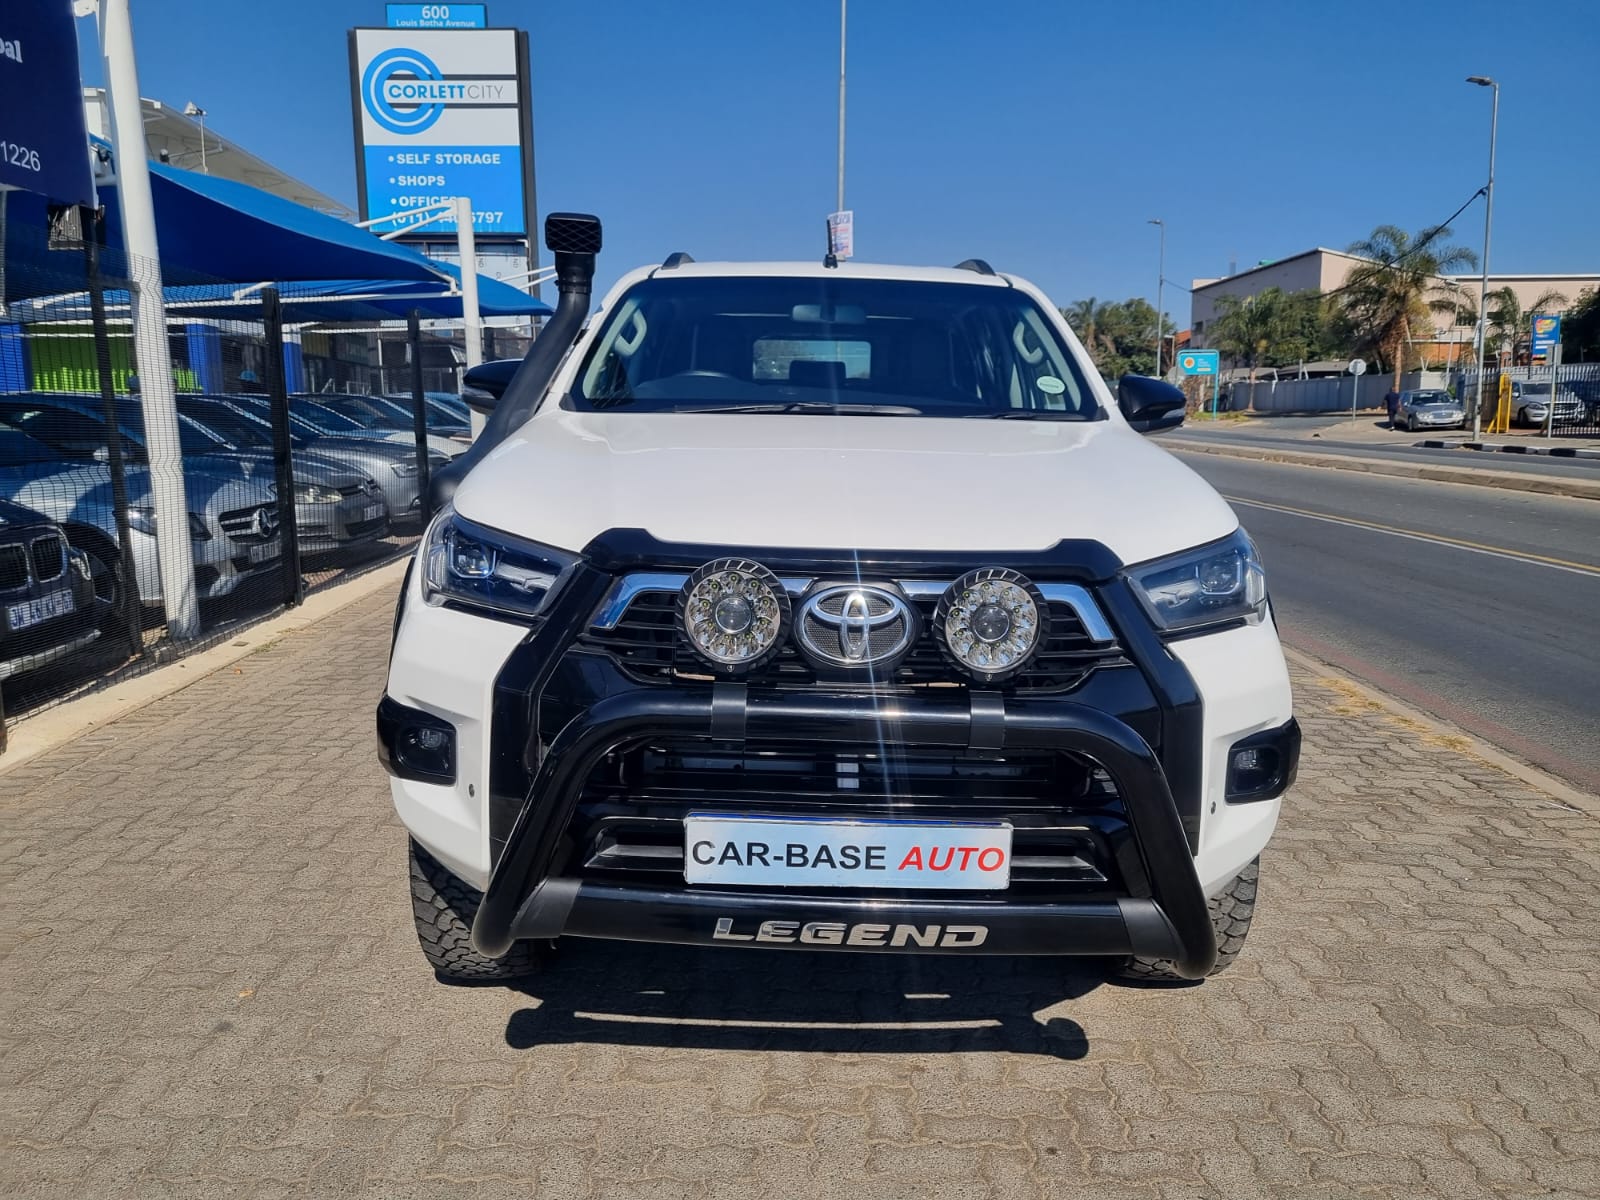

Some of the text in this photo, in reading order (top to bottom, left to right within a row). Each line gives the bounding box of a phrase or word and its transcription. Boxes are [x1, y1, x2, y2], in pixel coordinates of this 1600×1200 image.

[422, 5, 449, 19] 600
[396, 19, 417, 27] Louis
[420, 19, 443, 27] Botha
[388, 84, 504, 99] CORLETT CITY
[0, 138, 41, 172] 1226
[396, 153, 501, 165] SELF STORAGE
[398, 175, 446, 187] SHOPS
[692, 840, 1005, 872] CAR-BASE AUTO
[712, 917, 990, 947] LEGEND
